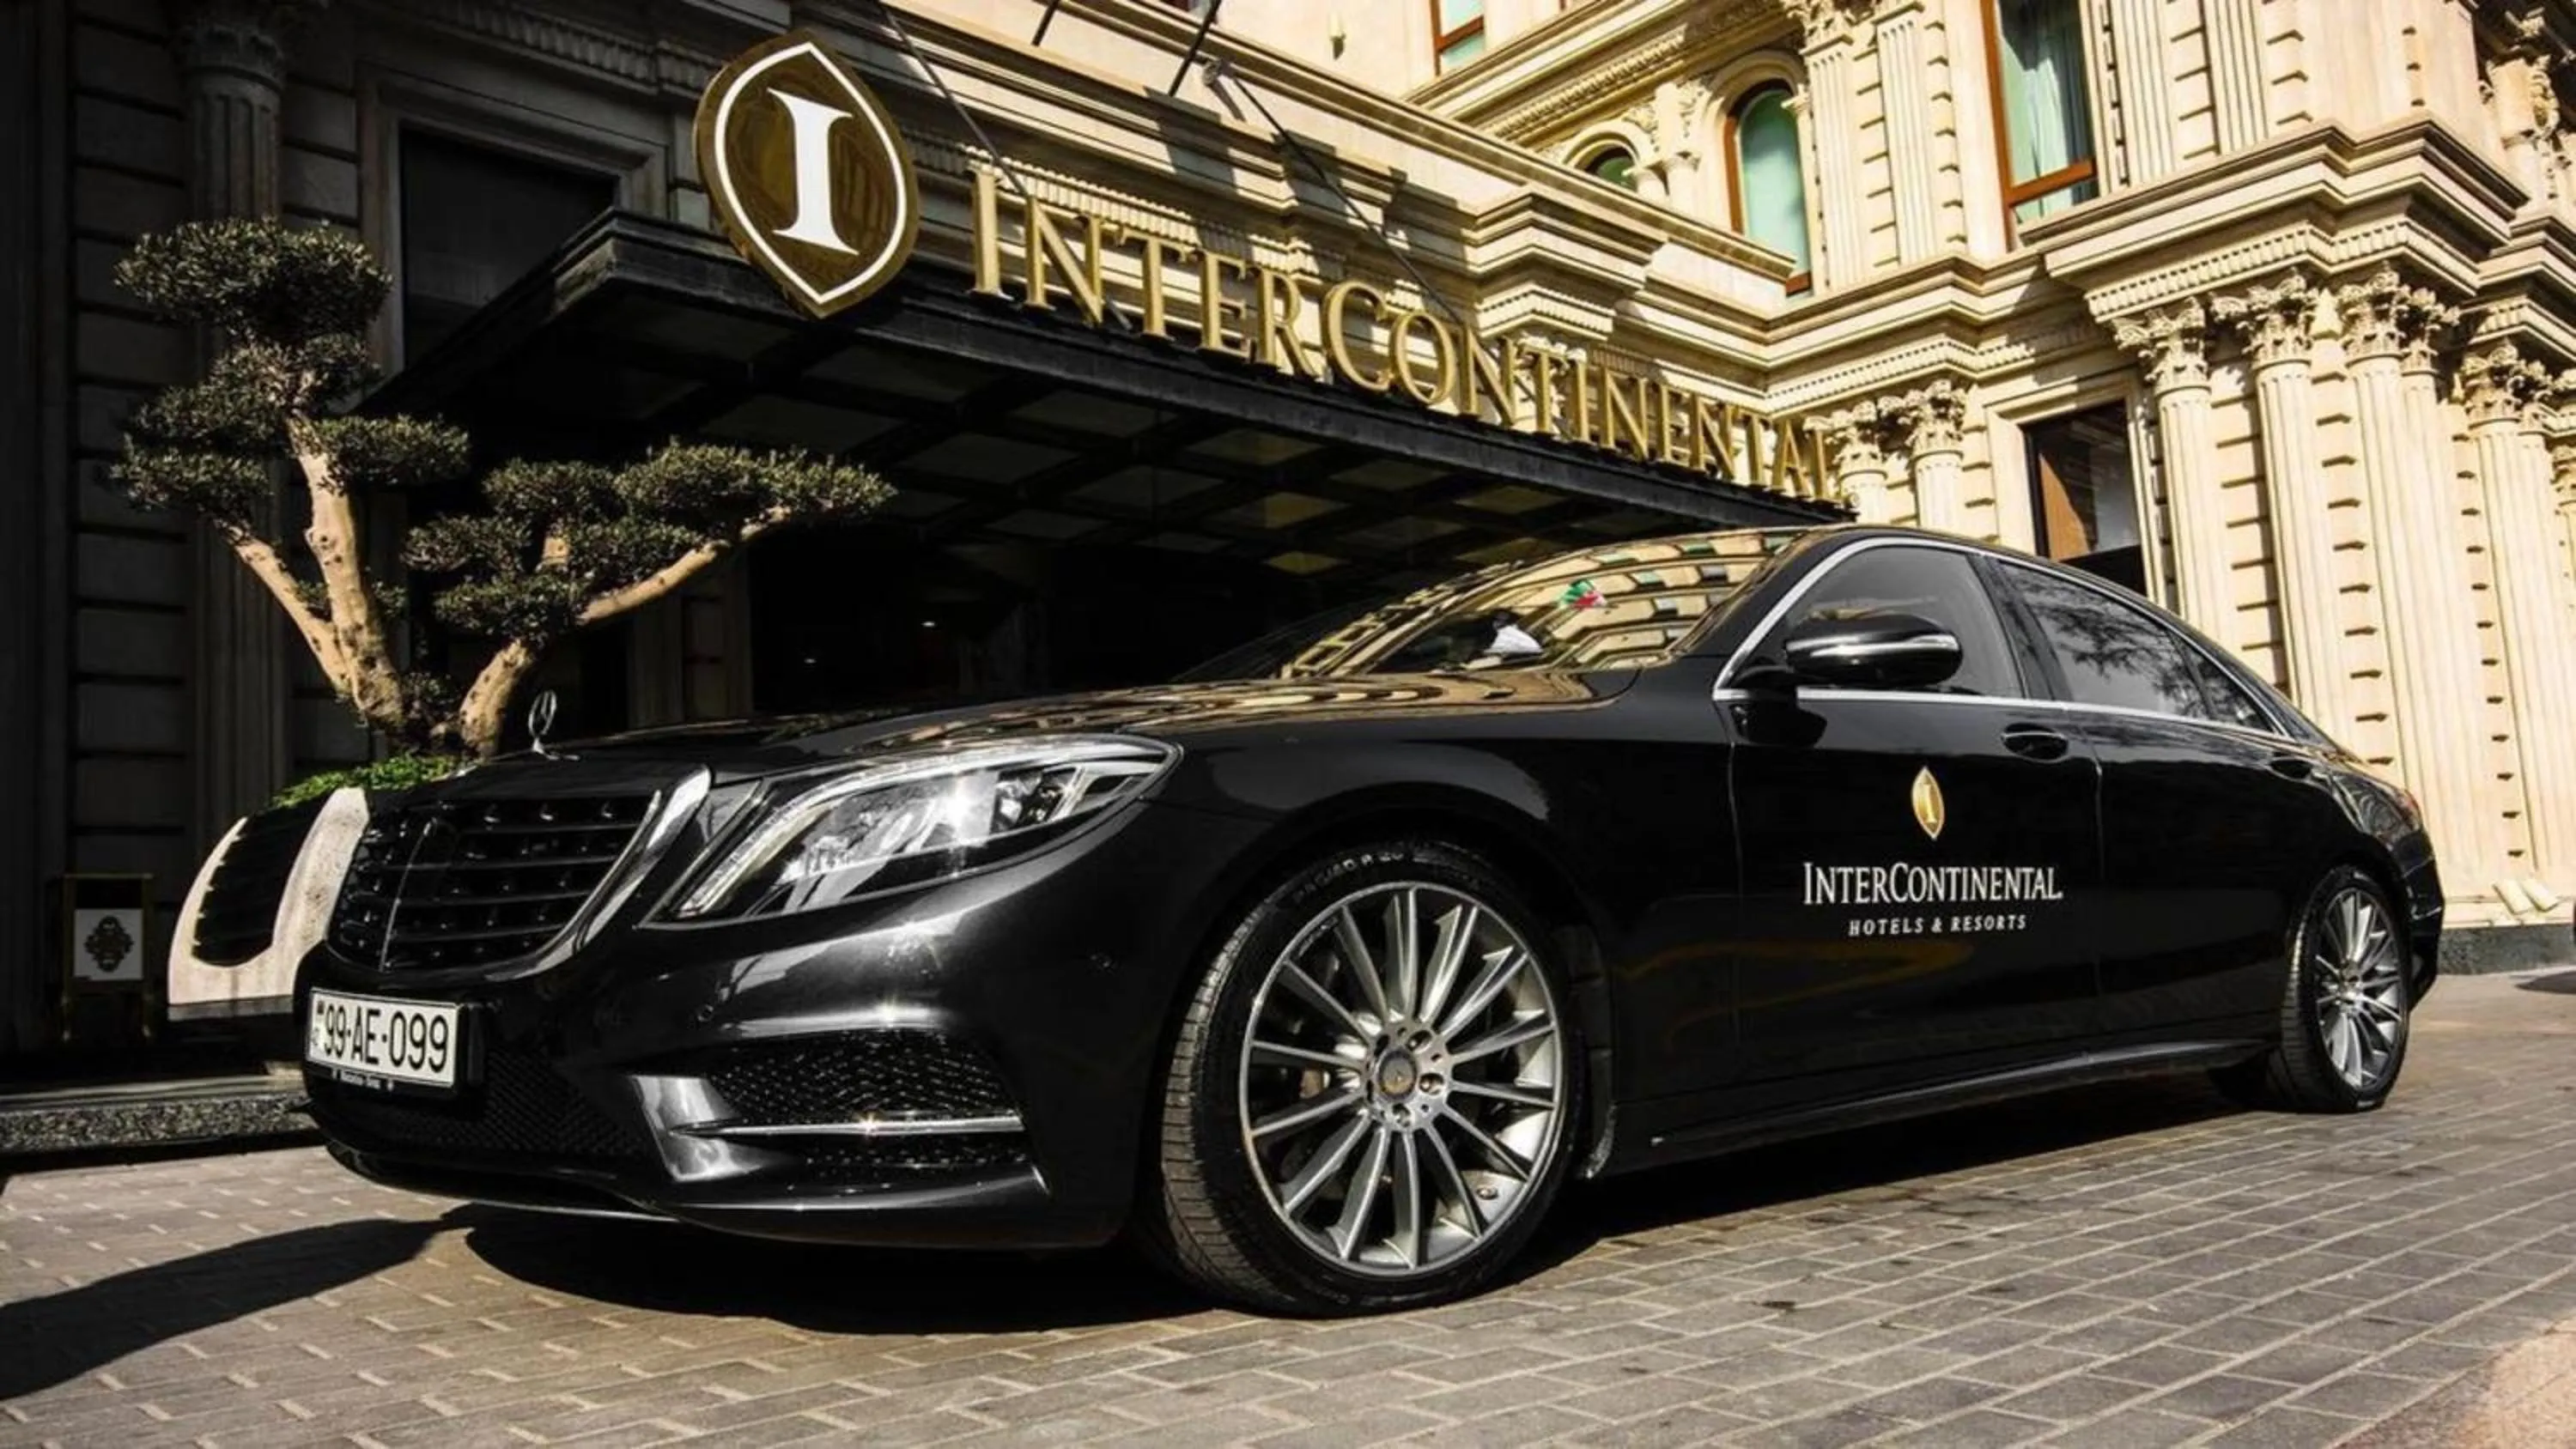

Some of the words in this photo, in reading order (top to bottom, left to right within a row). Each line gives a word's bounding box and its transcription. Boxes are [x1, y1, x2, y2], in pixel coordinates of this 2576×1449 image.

[767, 88, 860, 256] I
[967, 161, 1846, 505] INTERCONTINENTAL
[1803, 862, 2064, 905] INTERCONTINENTAL
[1848, 916, 1925, 937] HOTELS
[1931, 916, 1943, 933] &
[1950, 914, 2027, 932] RESORTS
[323, 1002, 449, 1073] 99-AE-099
